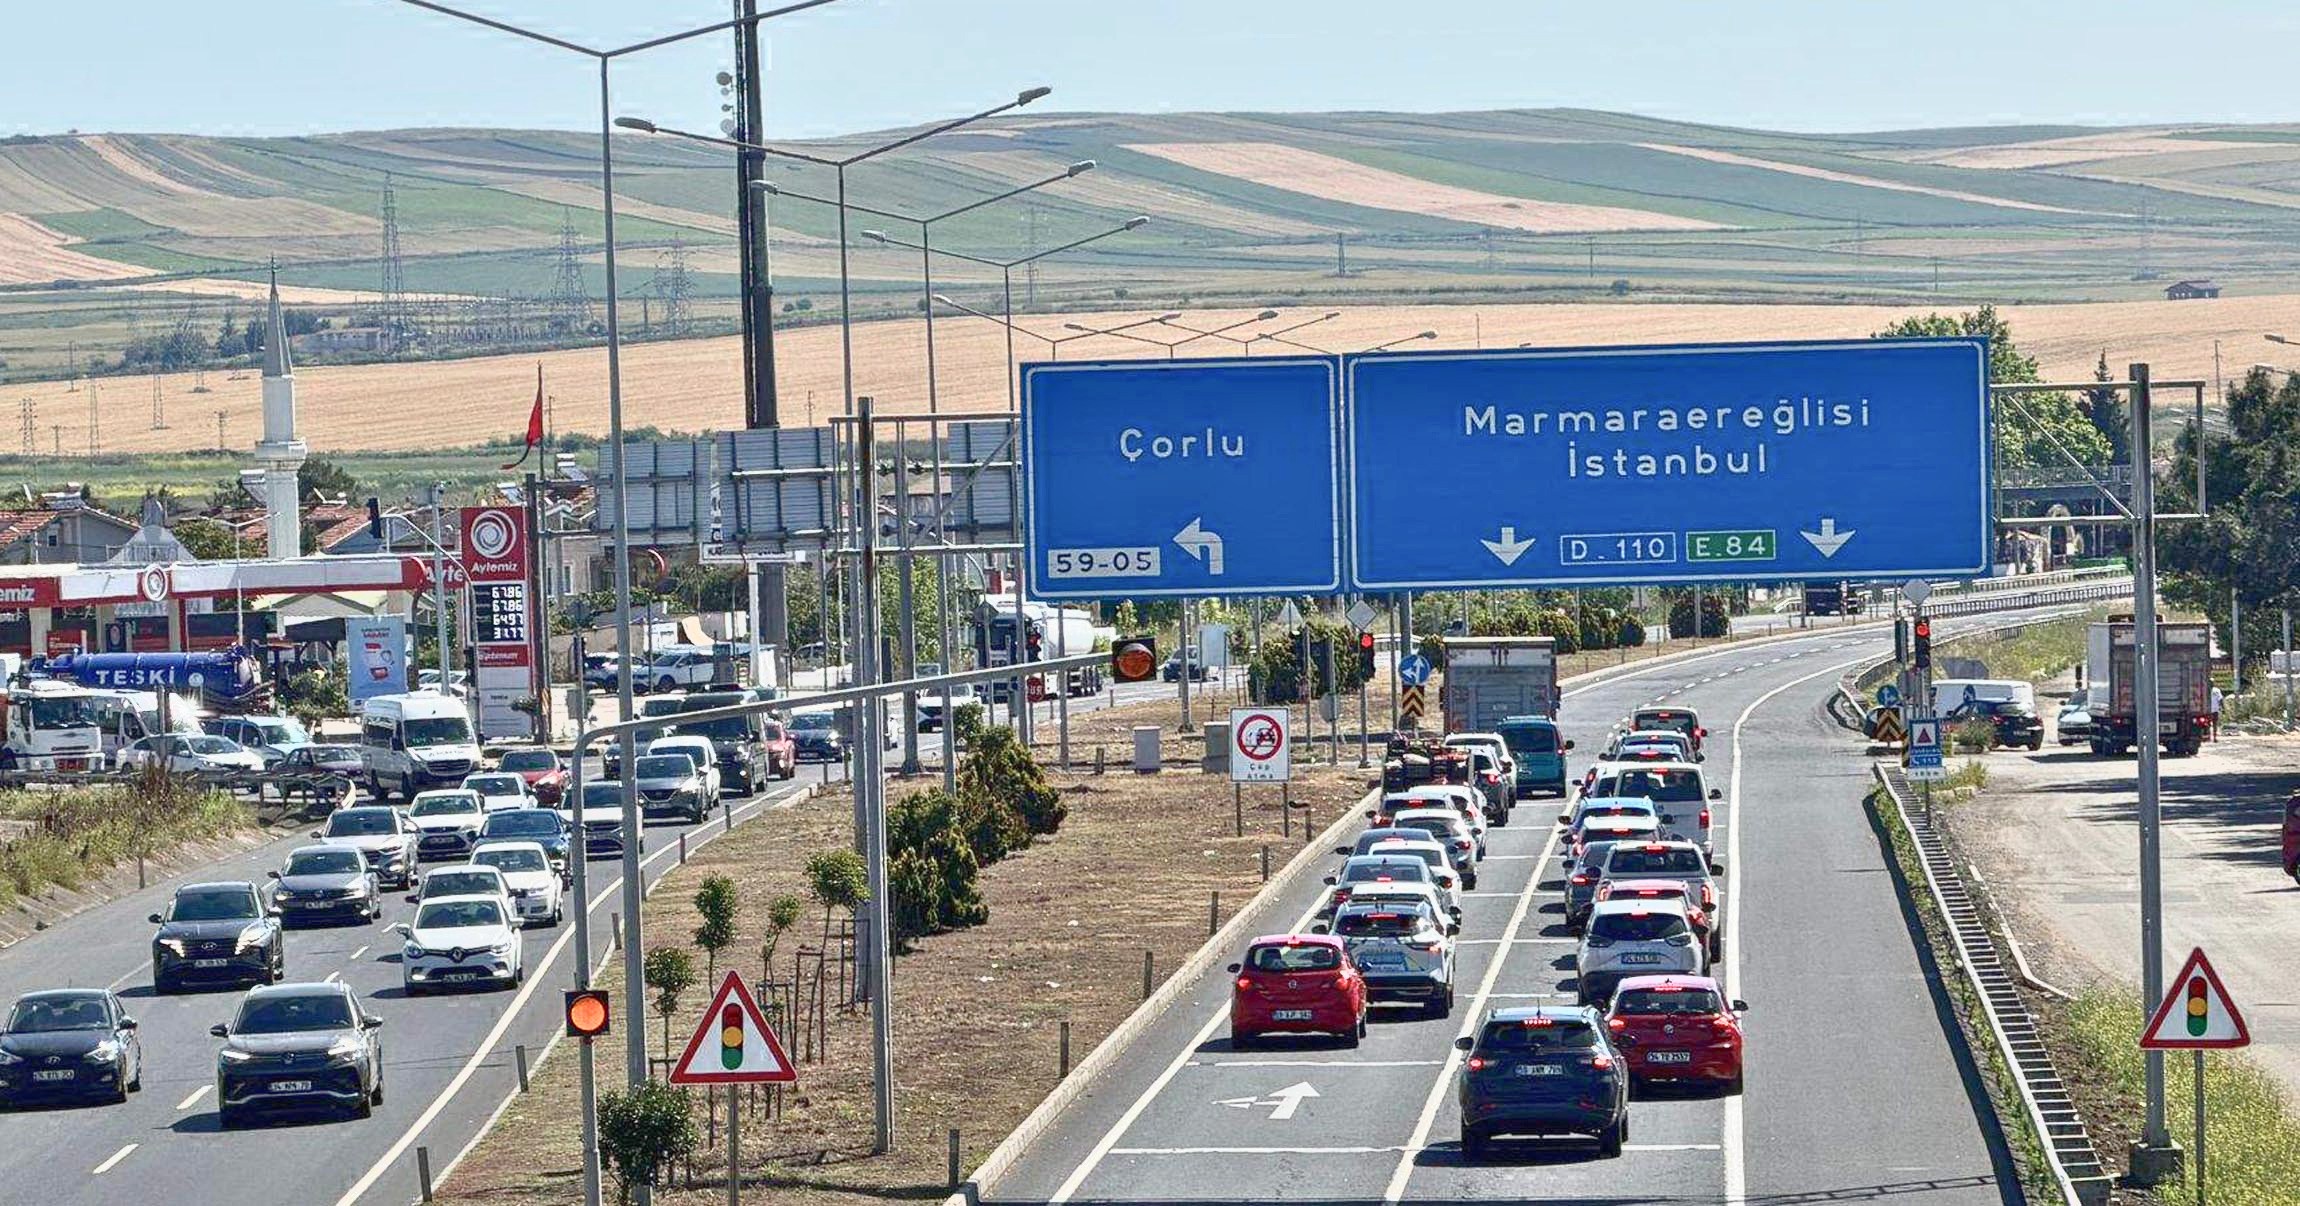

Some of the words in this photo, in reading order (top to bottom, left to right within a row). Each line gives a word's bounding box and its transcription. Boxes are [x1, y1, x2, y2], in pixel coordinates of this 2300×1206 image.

[1465, 399, 1871, 435] Marmaraereğlisi
[1119, 428, 1244, 462] Çorlu
[1568, 441, 1768, 478] İstanbul
[1695, 536, 1766, 558] E.84
[471, 561, 517, 573] Aytemiz
[1056, 551, 1152, 574] 59-05
